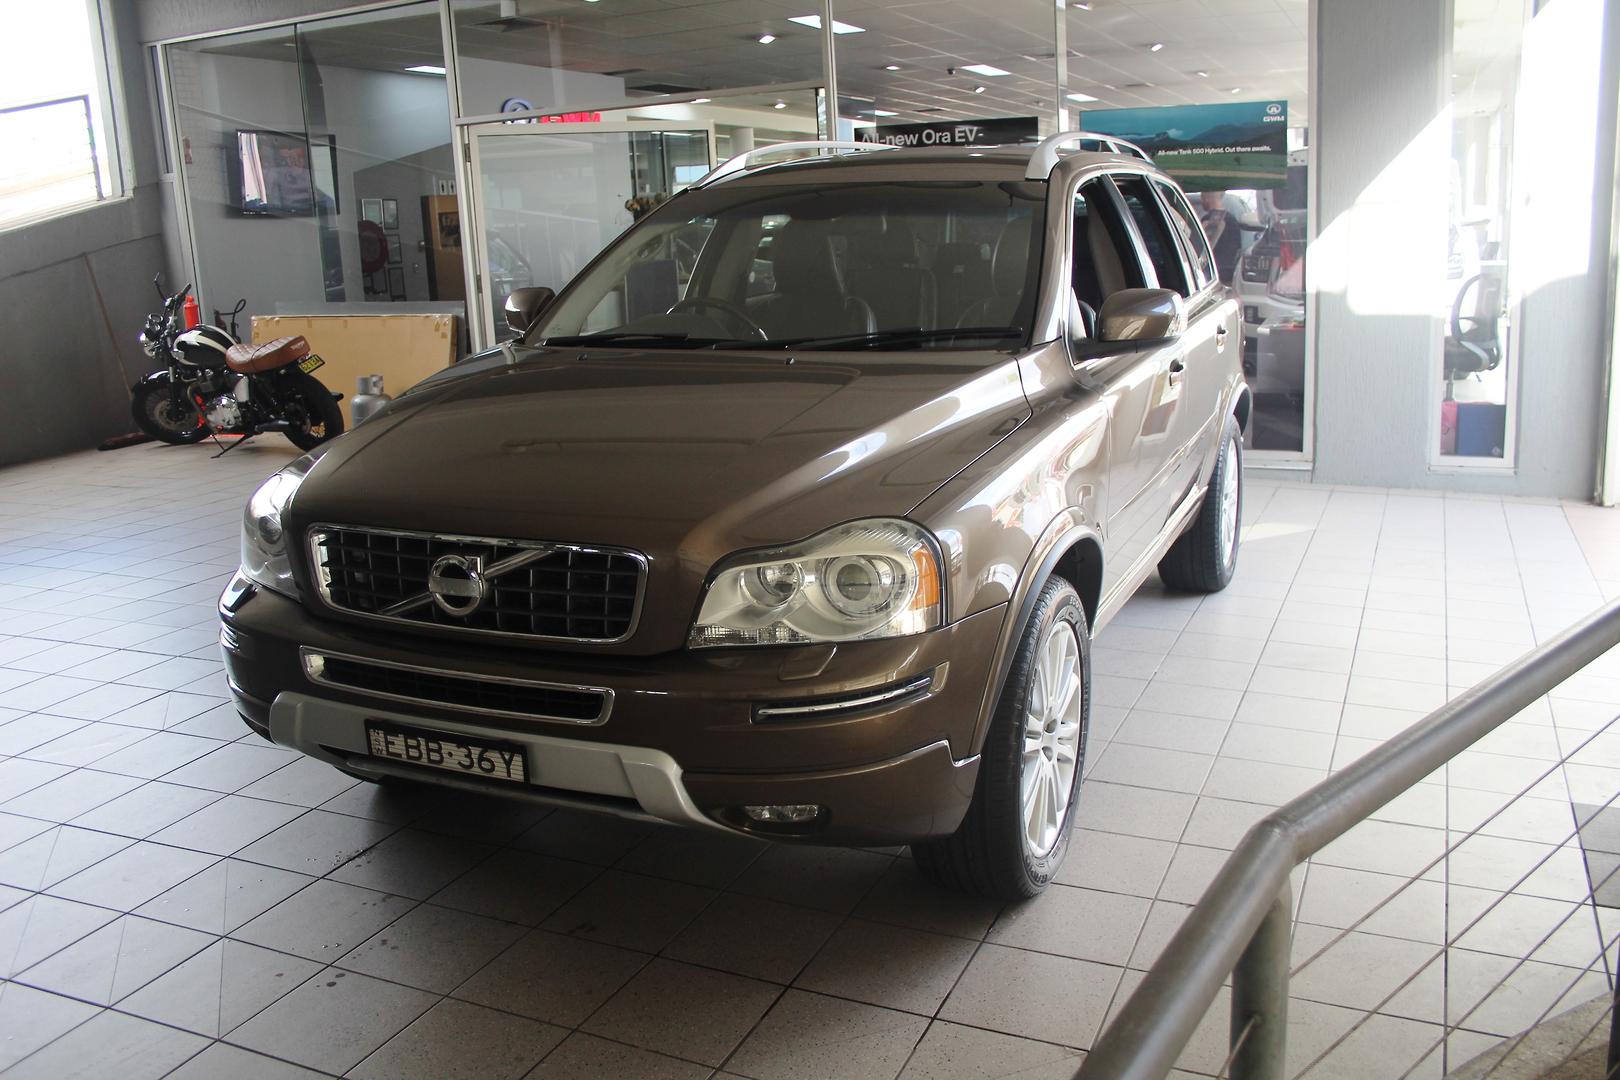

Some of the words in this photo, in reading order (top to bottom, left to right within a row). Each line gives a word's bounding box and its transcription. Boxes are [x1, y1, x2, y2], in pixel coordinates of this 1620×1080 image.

[861, 132, 919, 146] All-new
[922, 128, 951, 144] Ora
[955, 127, 978, 142] EV
[1204, 147, 1224, 156] Hybrid.
[1236, 145, 1251, 153] there
